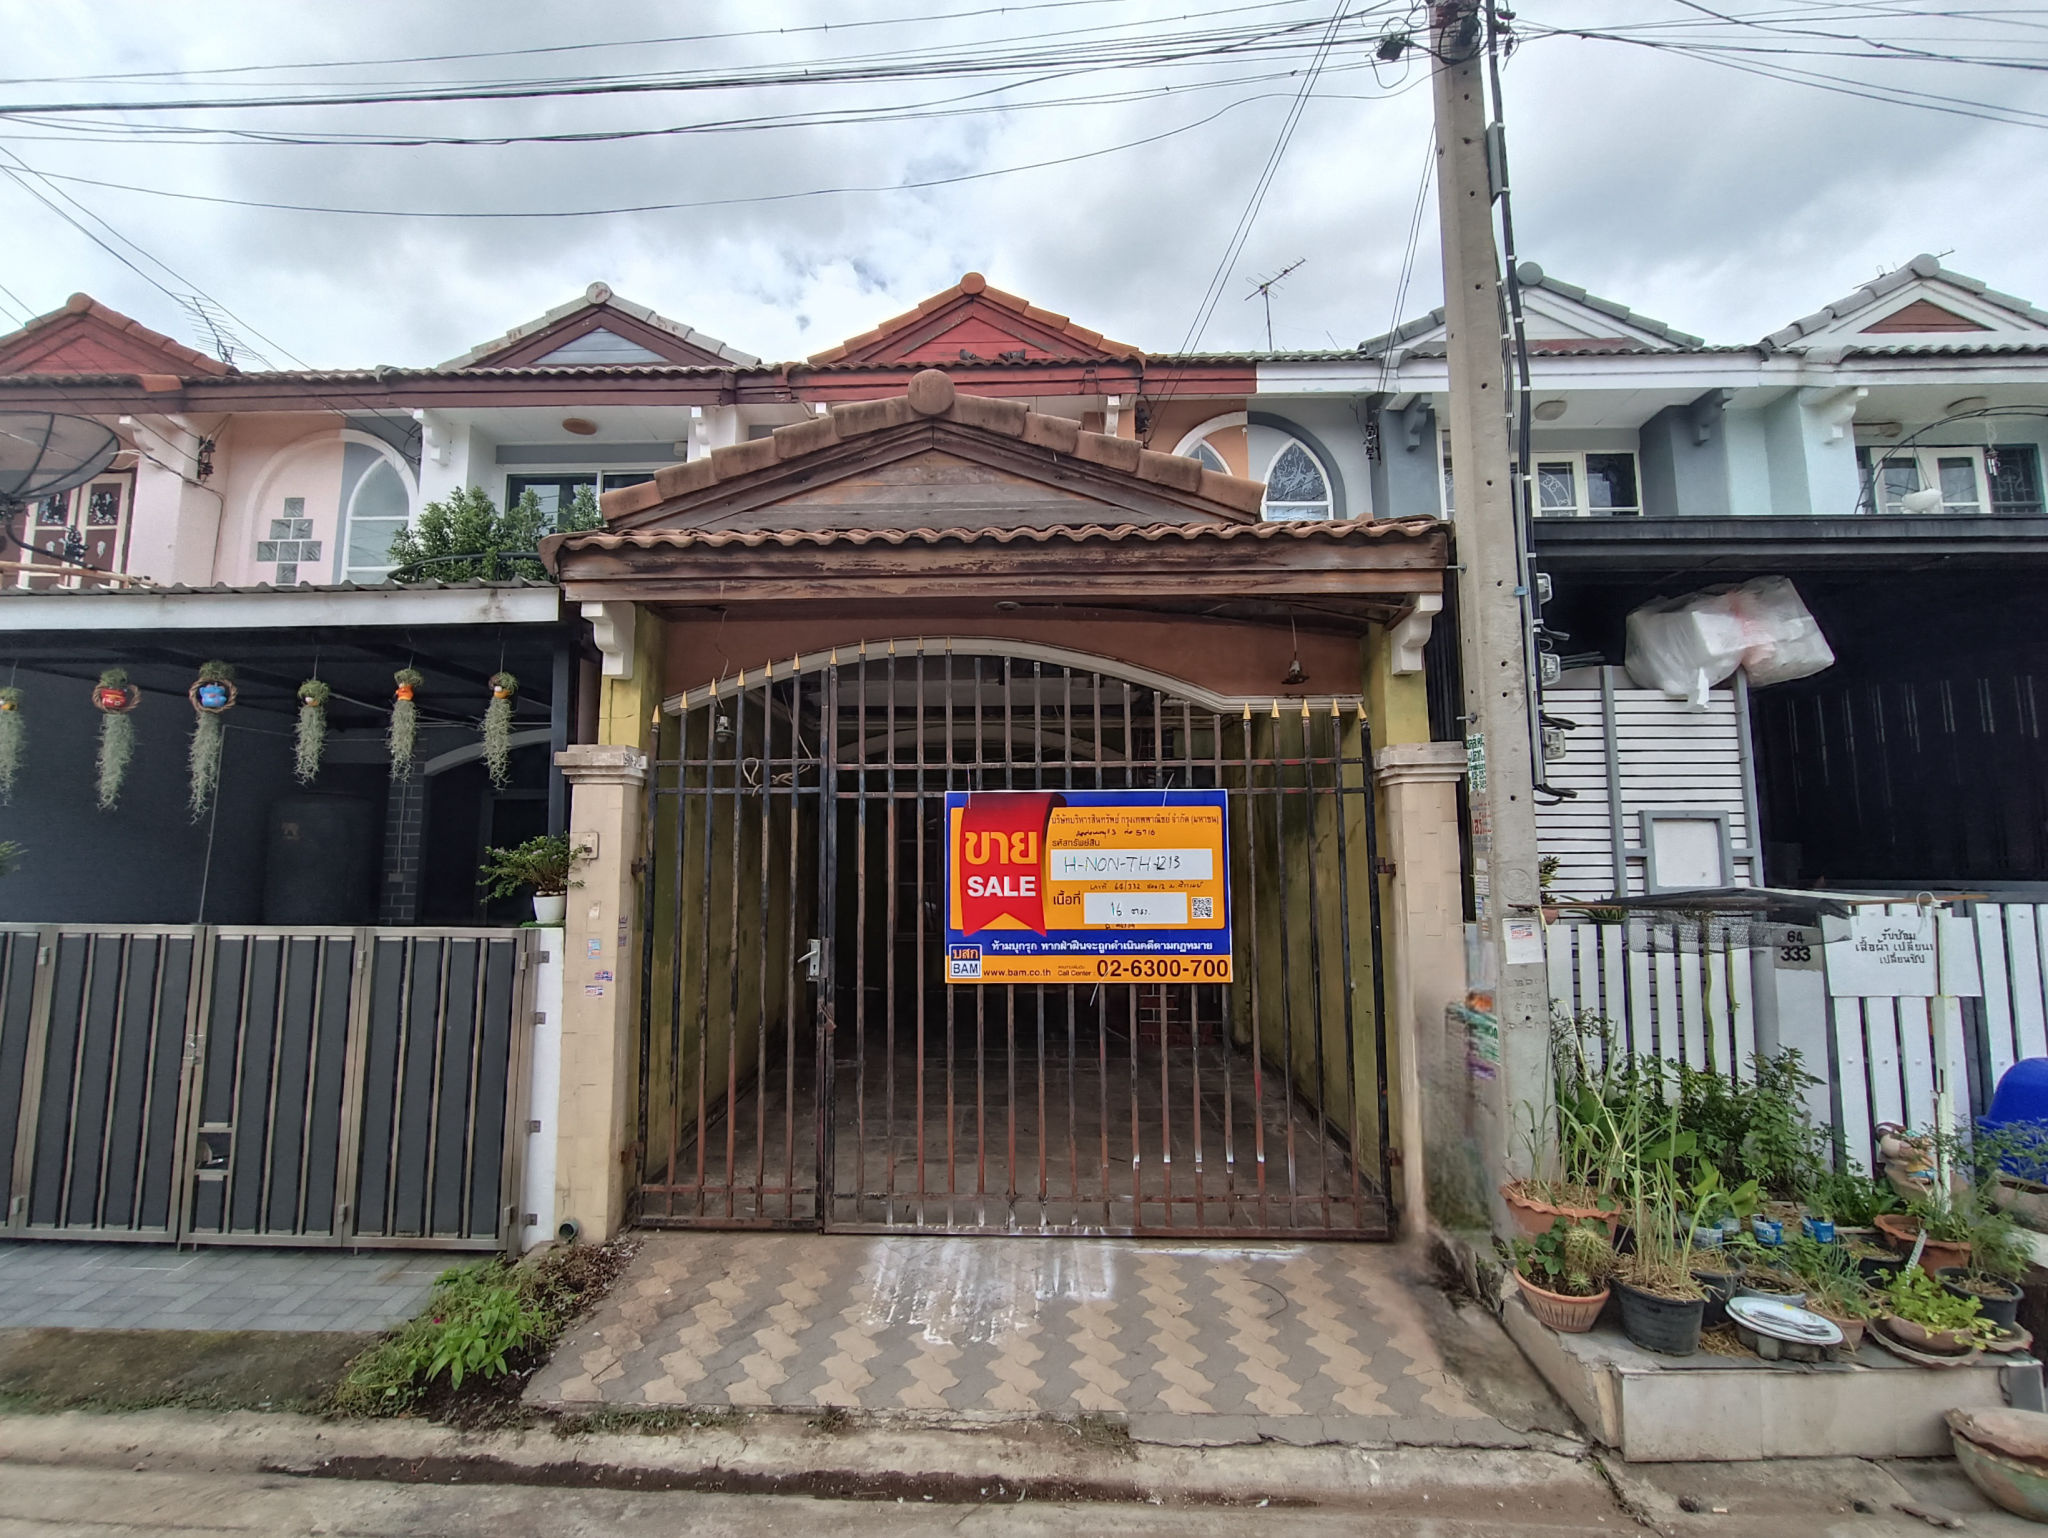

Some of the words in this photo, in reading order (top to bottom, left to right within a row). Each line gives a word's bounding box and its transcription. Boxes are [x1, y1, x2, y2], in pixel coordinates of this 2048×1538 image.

[1172, 812, 1189, 824] จำกัด
[1190, 814, 1219, 825] (มหาชน)
[964, 831, 1038, 865] ขาย
[967, 875, 1037, 898] SALE
[1053, 890, 1081, 905] เนื้อที่
[1110, 901, 1123, 917] 16
[1786, 930, 1805, 944] 64
[952, 947, 979, 960] บสก
[991, 939, 1038, 954] ห้ามบุกรุก
[1780, 946, 1812, 962] 333
[953, 963, 979, 974] BAM
[983, 967, 1052, 977] www.bam.co.th
[1096, 959, 1229, 978] 02-6300-700
